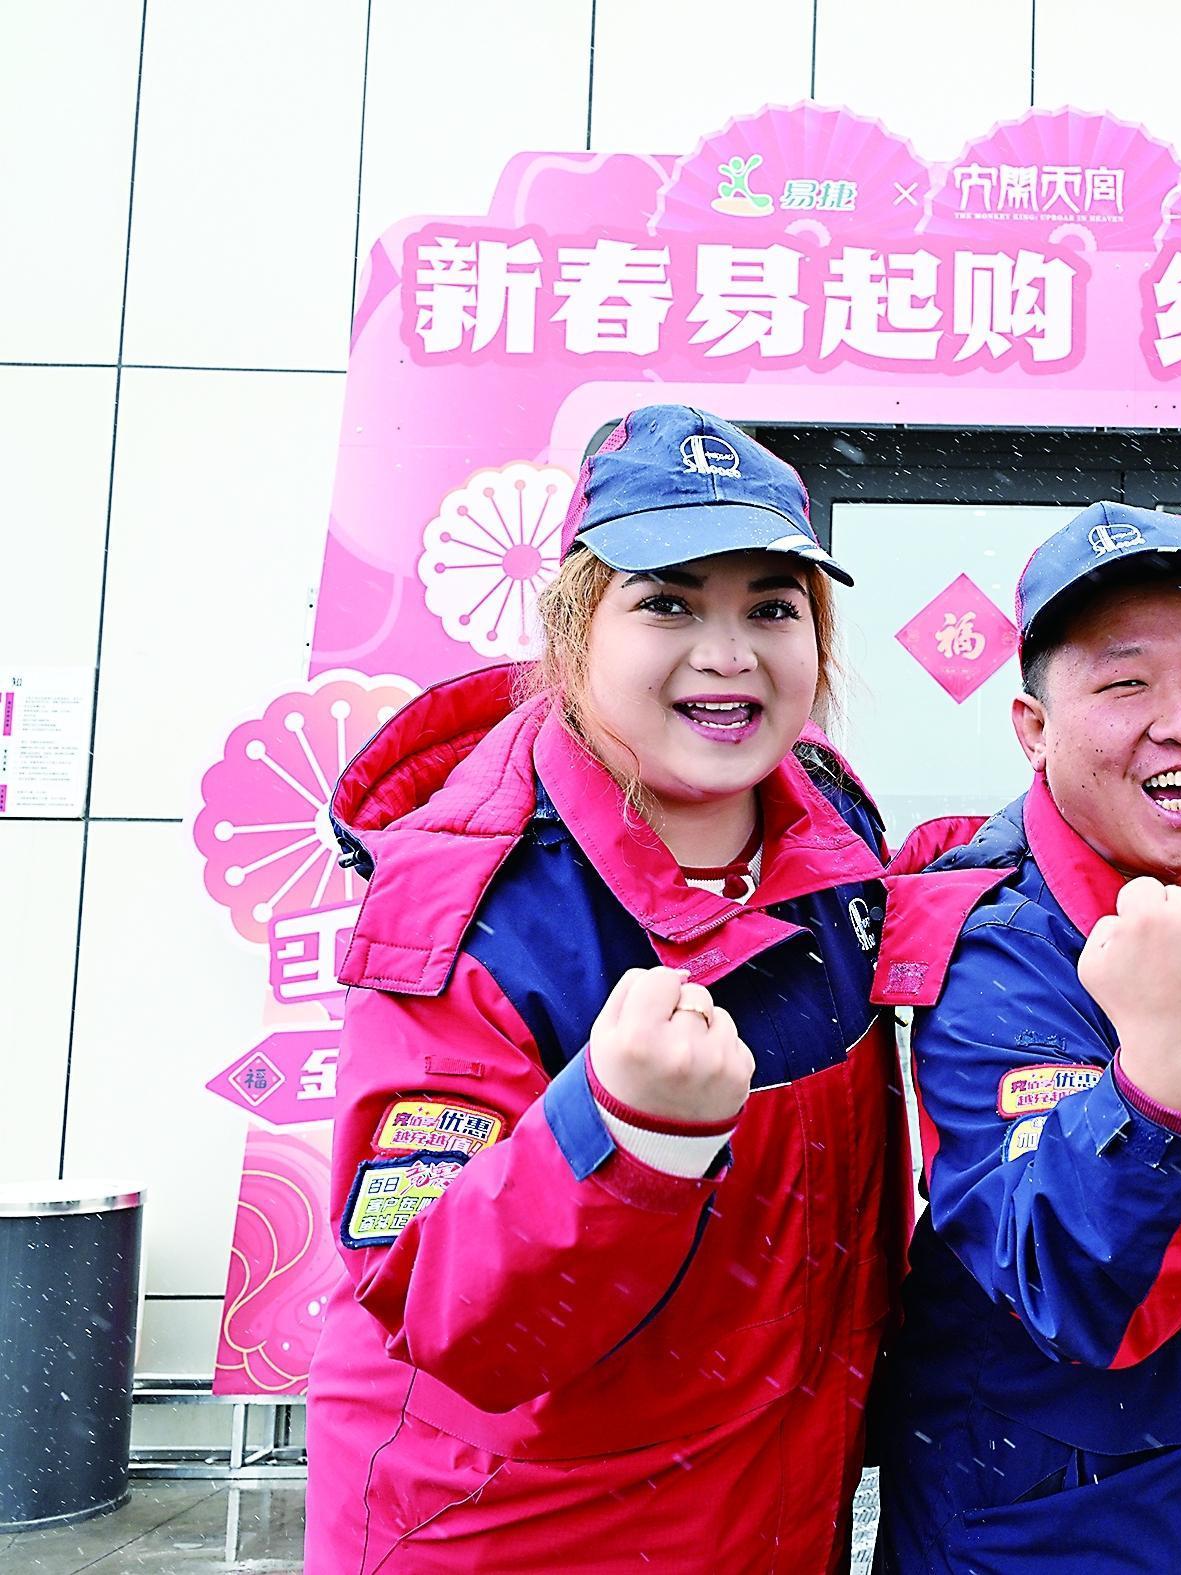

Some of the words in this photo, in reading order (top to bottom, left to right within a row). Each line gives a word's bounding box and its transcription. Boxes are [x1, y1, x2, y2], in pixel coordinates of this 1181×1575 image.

[779, 180, 858, 211] 易捷
[954, 212, 973, 220] THE
[1088, 215, 1125, 223] HEAVEN
[414, 236, 1077, 363] 新春易起购
[935, 611, 986, 660] 福
[244, 1068, 268, 1090] 福
